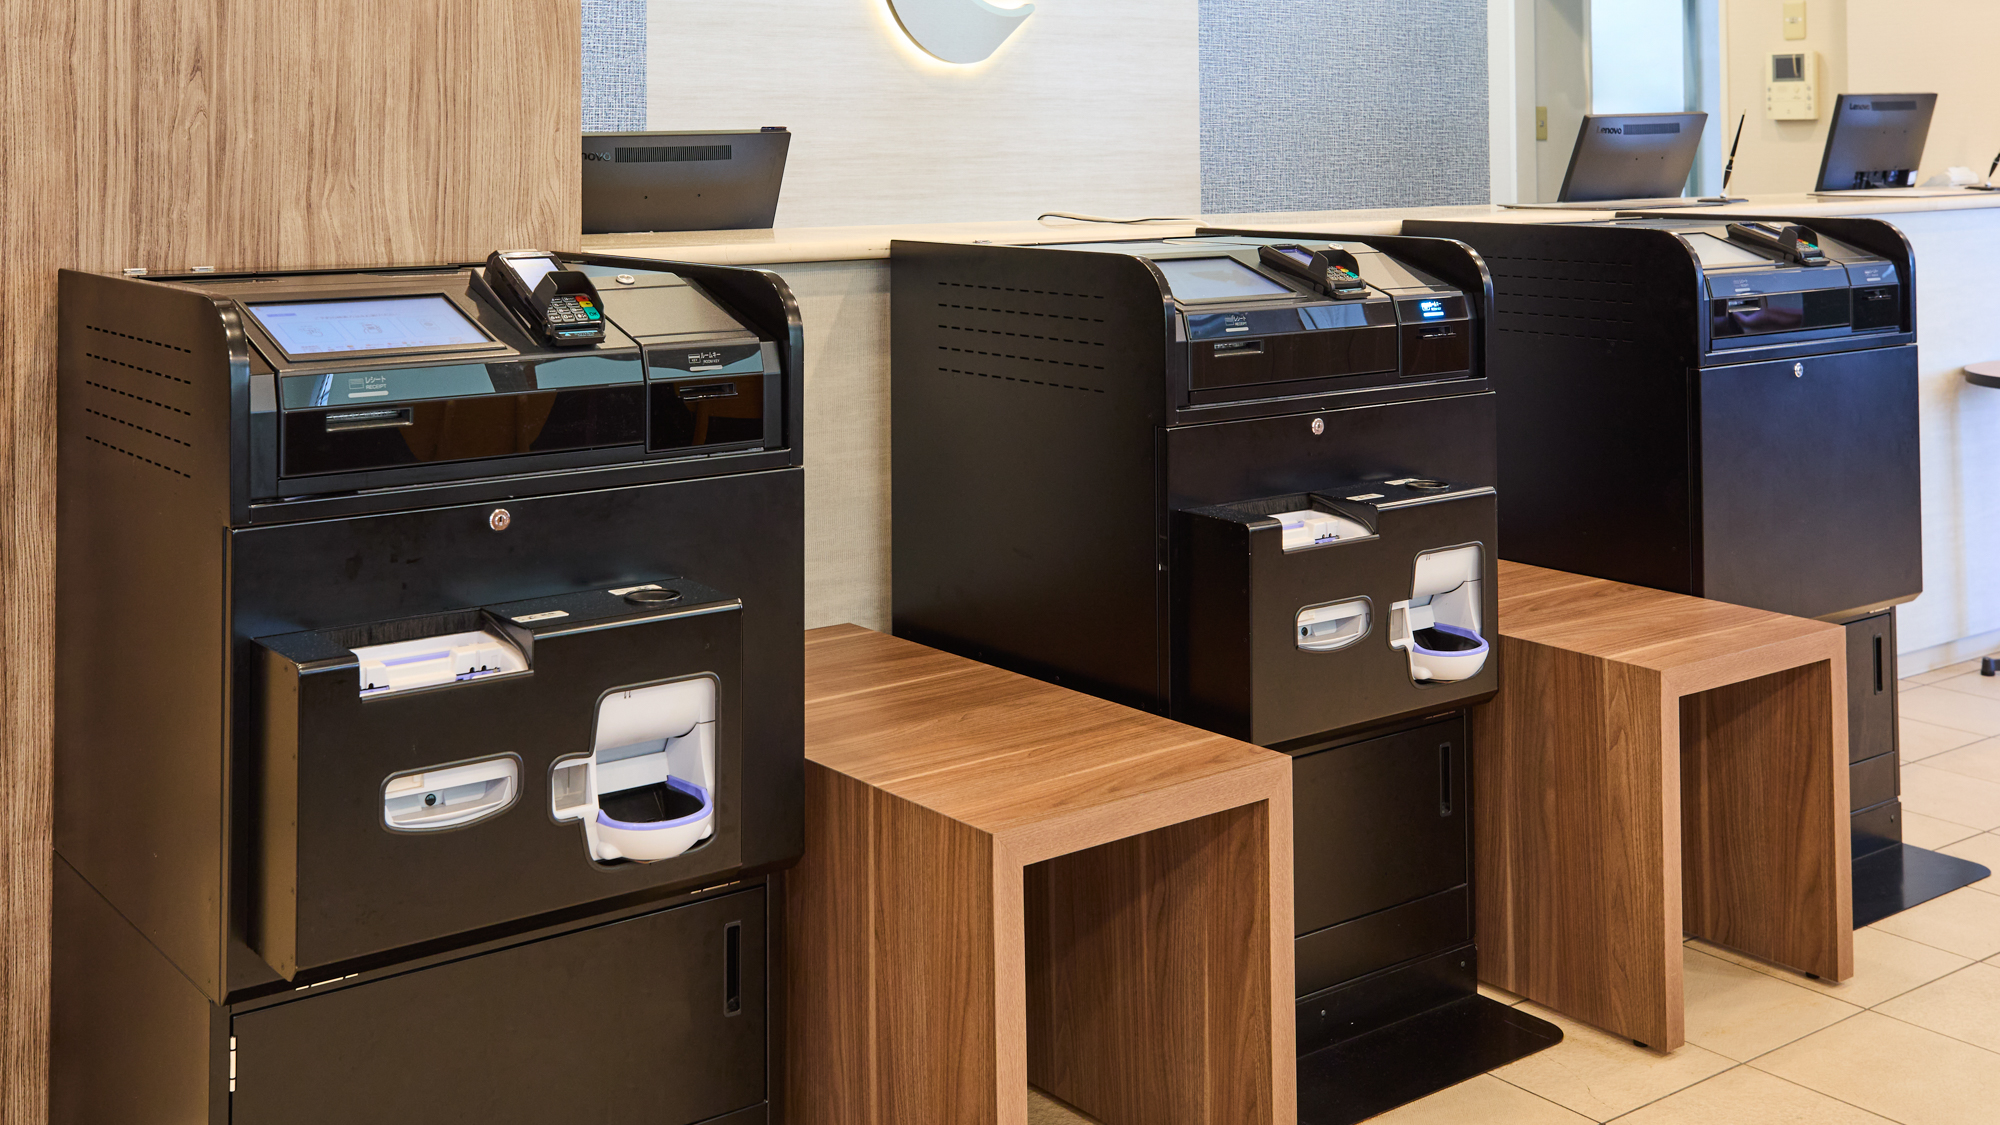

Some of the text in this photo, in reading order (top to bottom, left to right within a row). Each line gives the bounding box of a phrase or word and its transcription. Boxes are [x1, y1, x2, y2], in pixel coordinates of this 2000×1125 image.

[1596, 126, 1622, 134] Lenovo
[582, 152, 611, 161] novo
[364, 375, 386, 384] レシート
